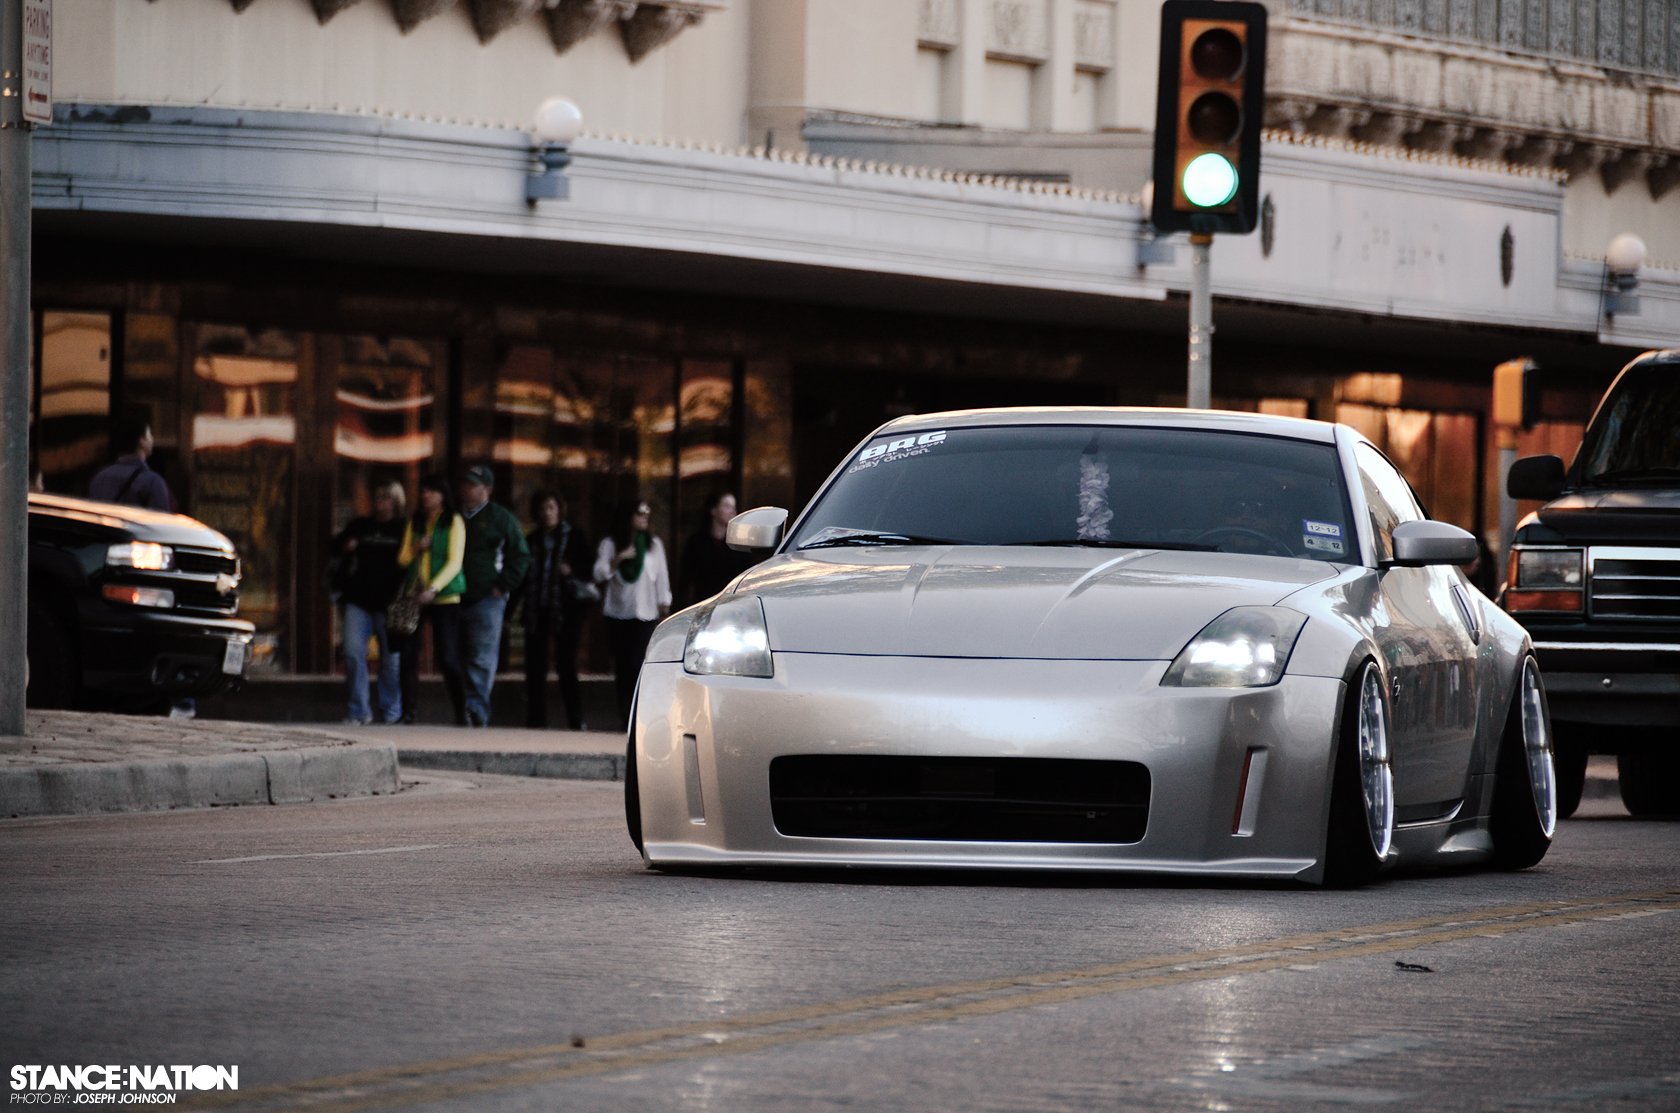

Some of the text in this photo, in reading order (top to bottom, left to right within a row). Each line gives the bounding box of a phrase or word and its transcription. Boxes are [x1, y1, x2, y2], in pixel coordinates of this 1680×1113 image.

[26, 6, 49, 39] PARKING
[26, 42, 49, 65] ANYTIME
[849, 459, 880, 474] daily
[1309, 525, 1338, 534] 12-12
[1331, 542, 1341, 550] 12
